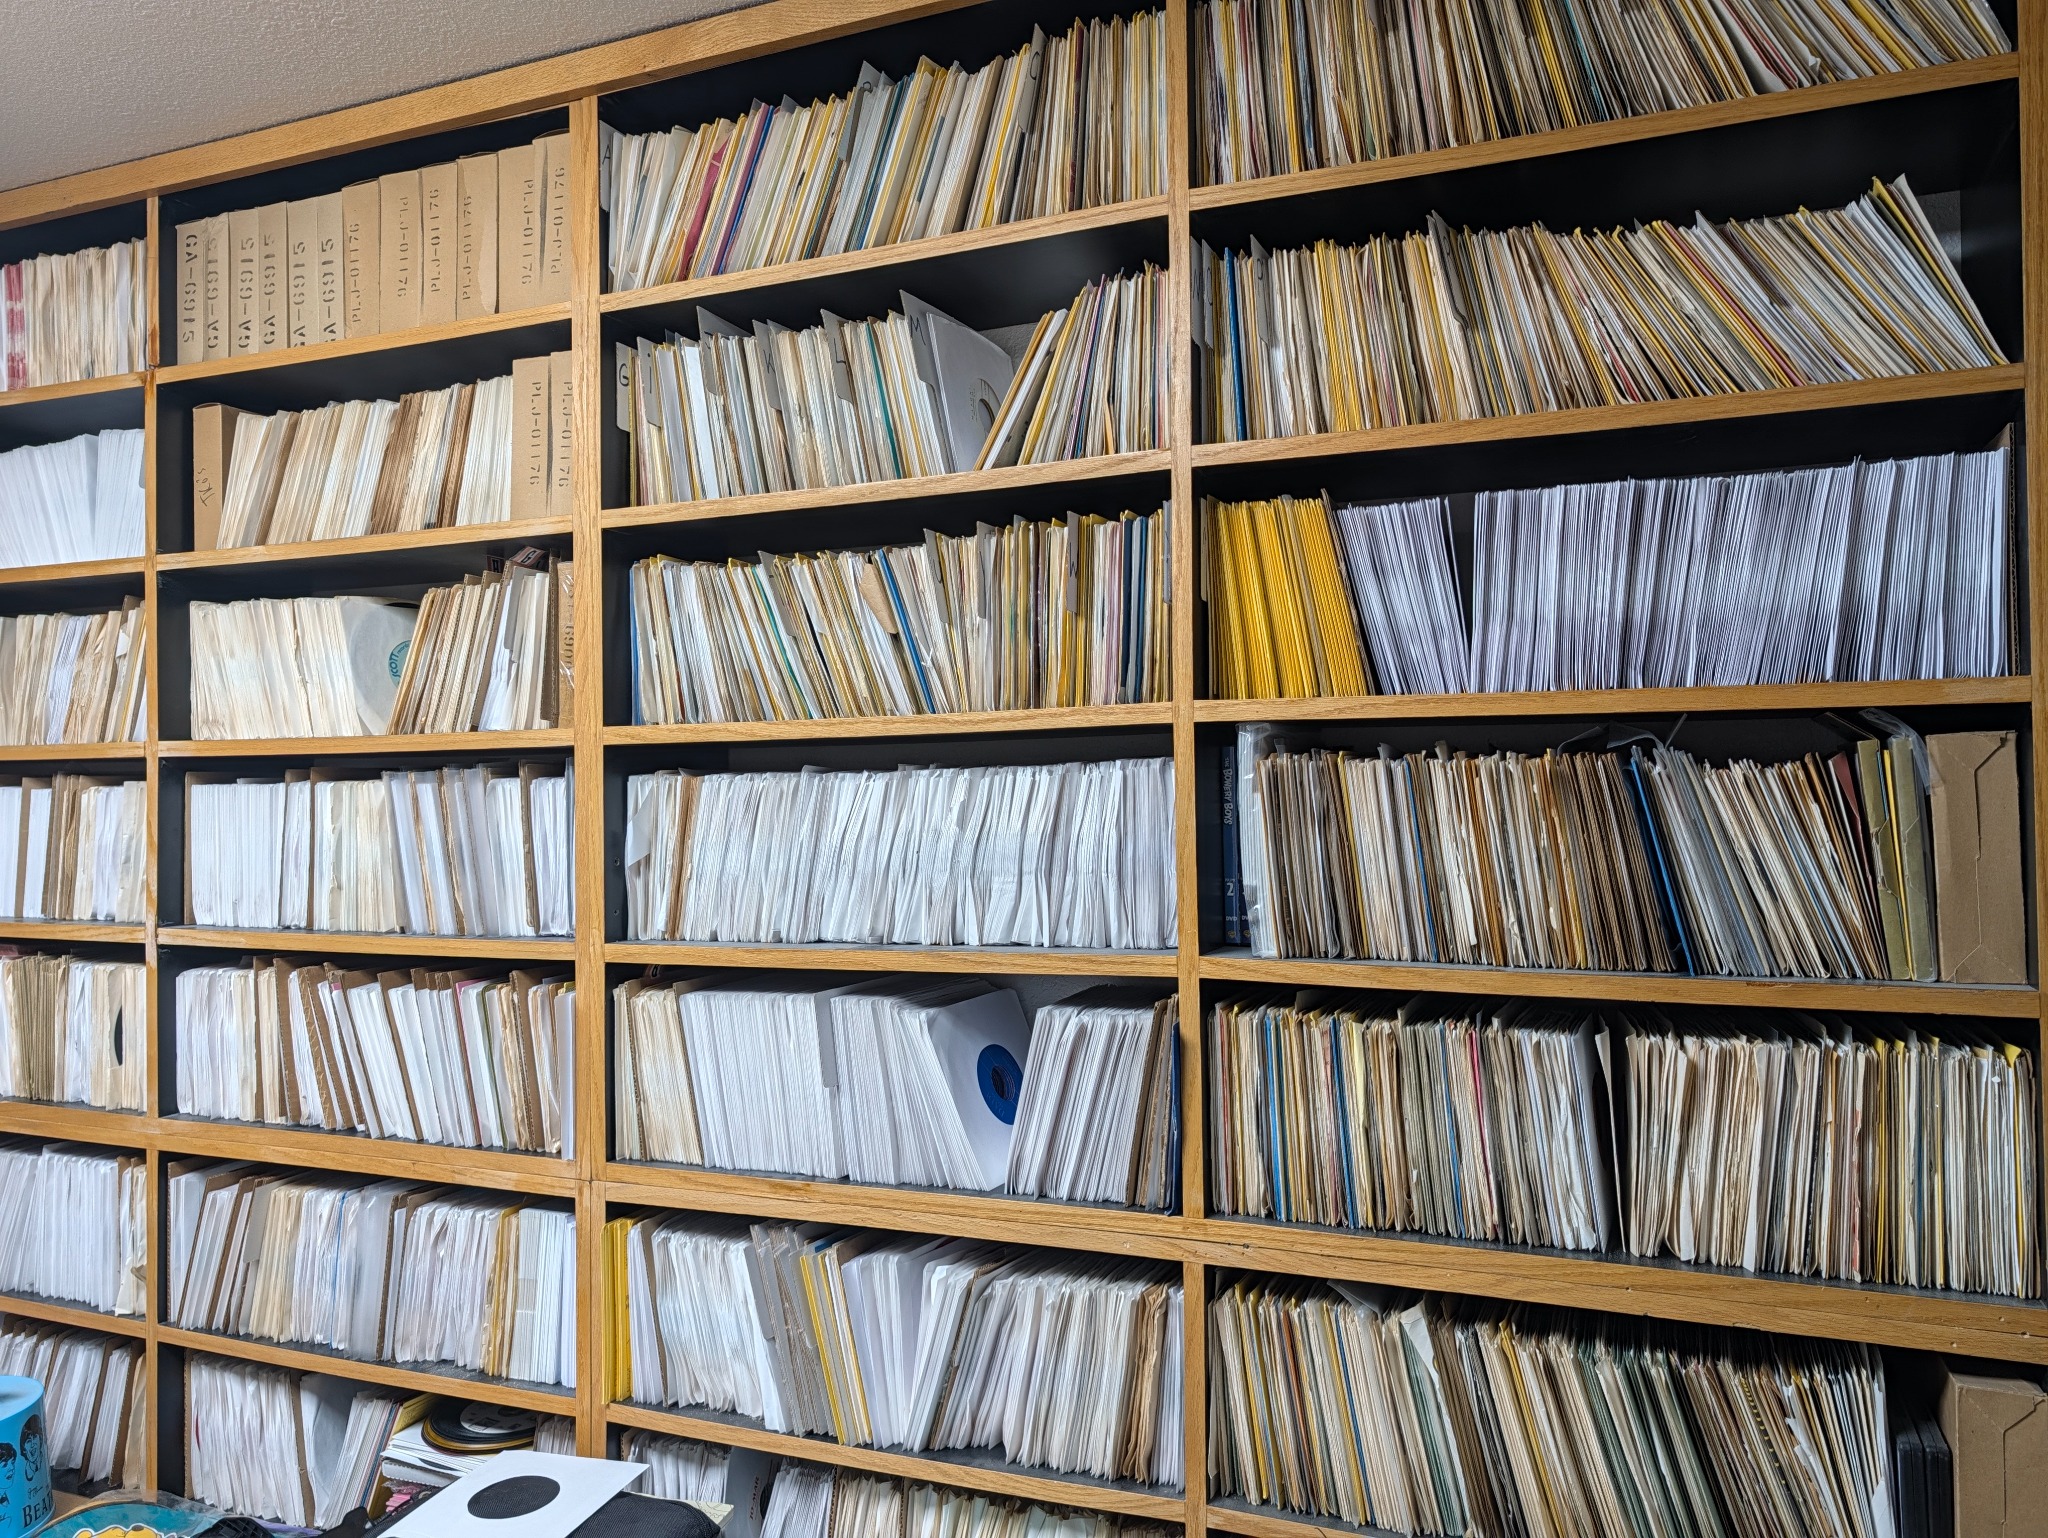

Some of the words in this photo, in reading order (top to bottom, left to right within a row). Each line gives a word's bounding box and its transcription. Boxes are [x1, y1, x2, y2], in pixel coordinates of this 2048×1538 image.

[397, 197, 409, 298] PLJ-01176
[430, 189, 441, 293] PLJ-01176
[462, 196, 473, 300] PLJ-01176
[522, 179, 534, 285] PLJ-01176
[551, 167, 565, 274] PLJ-01176
[183, 234, 198, 343] GA-6915
[207, 237, 219, 349] GA-6915
[238, 237, 254, 348] GA-6915
[264, 234, 276, 345] GA-6915
[321, 238, 337, 343] A-6915
[349, 223, 362, 323] PLJ-01176
[618, 363, 630, 387] G
[910, 314, 926, 346] M
[530, 381, 542, 485] PLJ-01176
[1222, 768, 1233, 802] BOWERY
[1223, 802, 1234, 825] BOYS
[1226, 882, 1235, 897] 2
